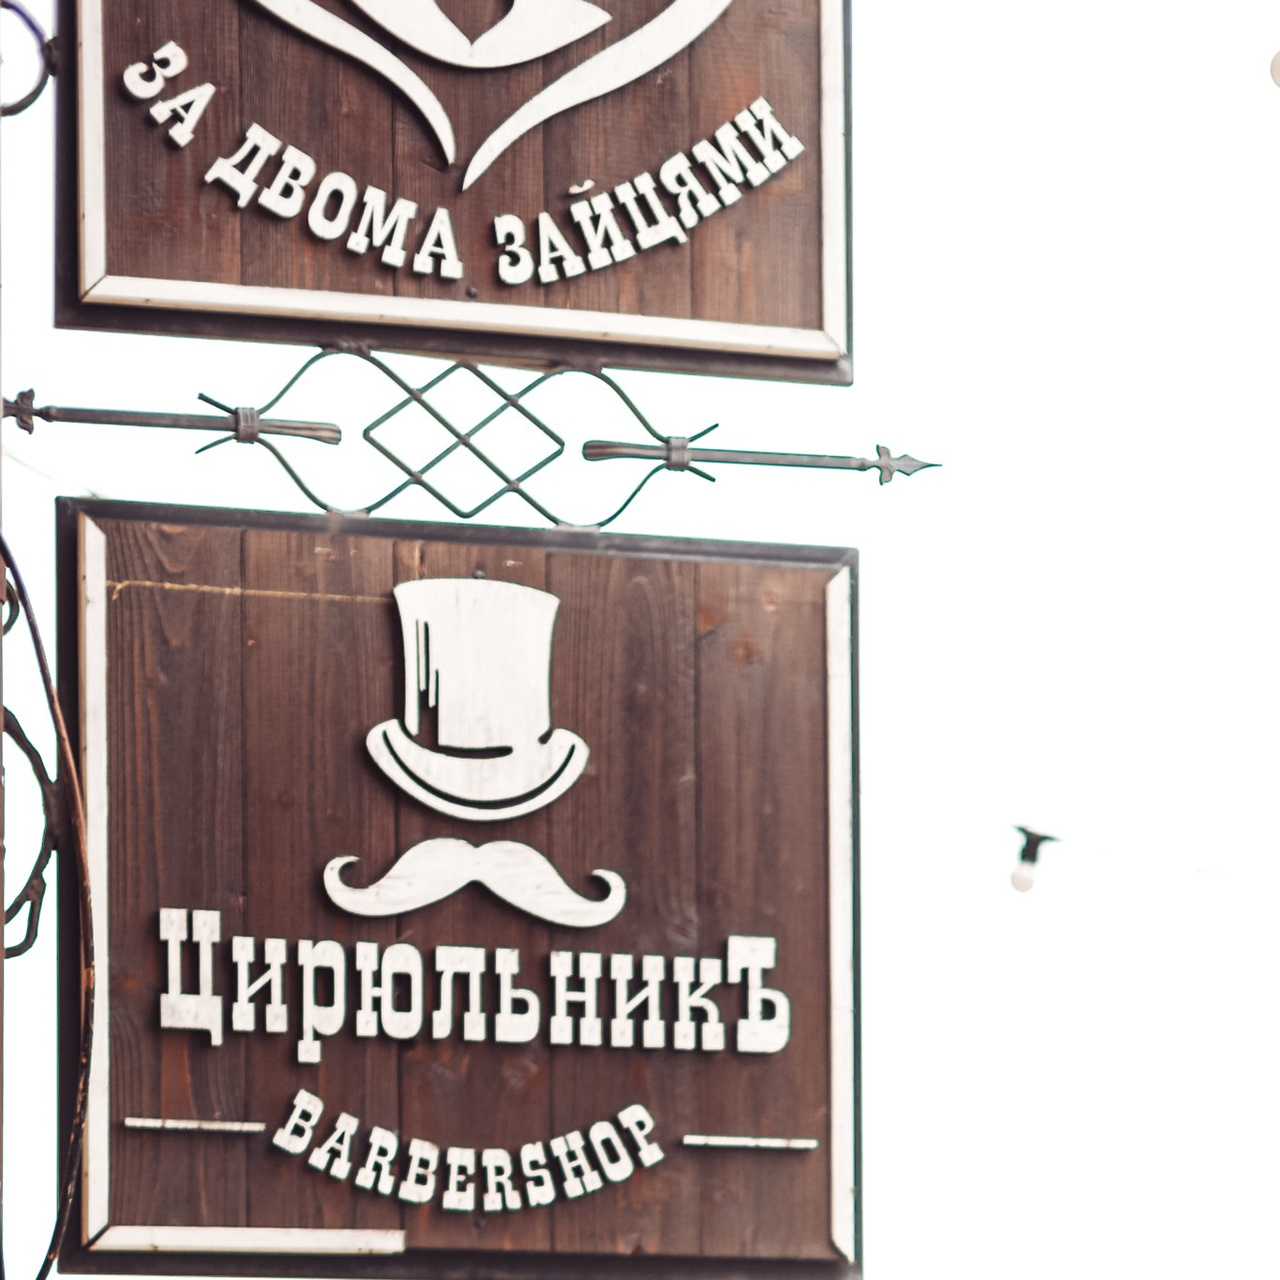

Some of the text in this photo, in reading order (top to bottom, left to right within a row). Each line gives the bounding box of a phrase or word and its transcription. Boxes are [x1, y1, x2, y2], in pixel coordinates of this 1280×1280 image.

[123, 40, 806, 286] ЗА ДВОМА ЗАЙЦЯМИ
[272, 1088, 665, 1212] BARBERSHOP
